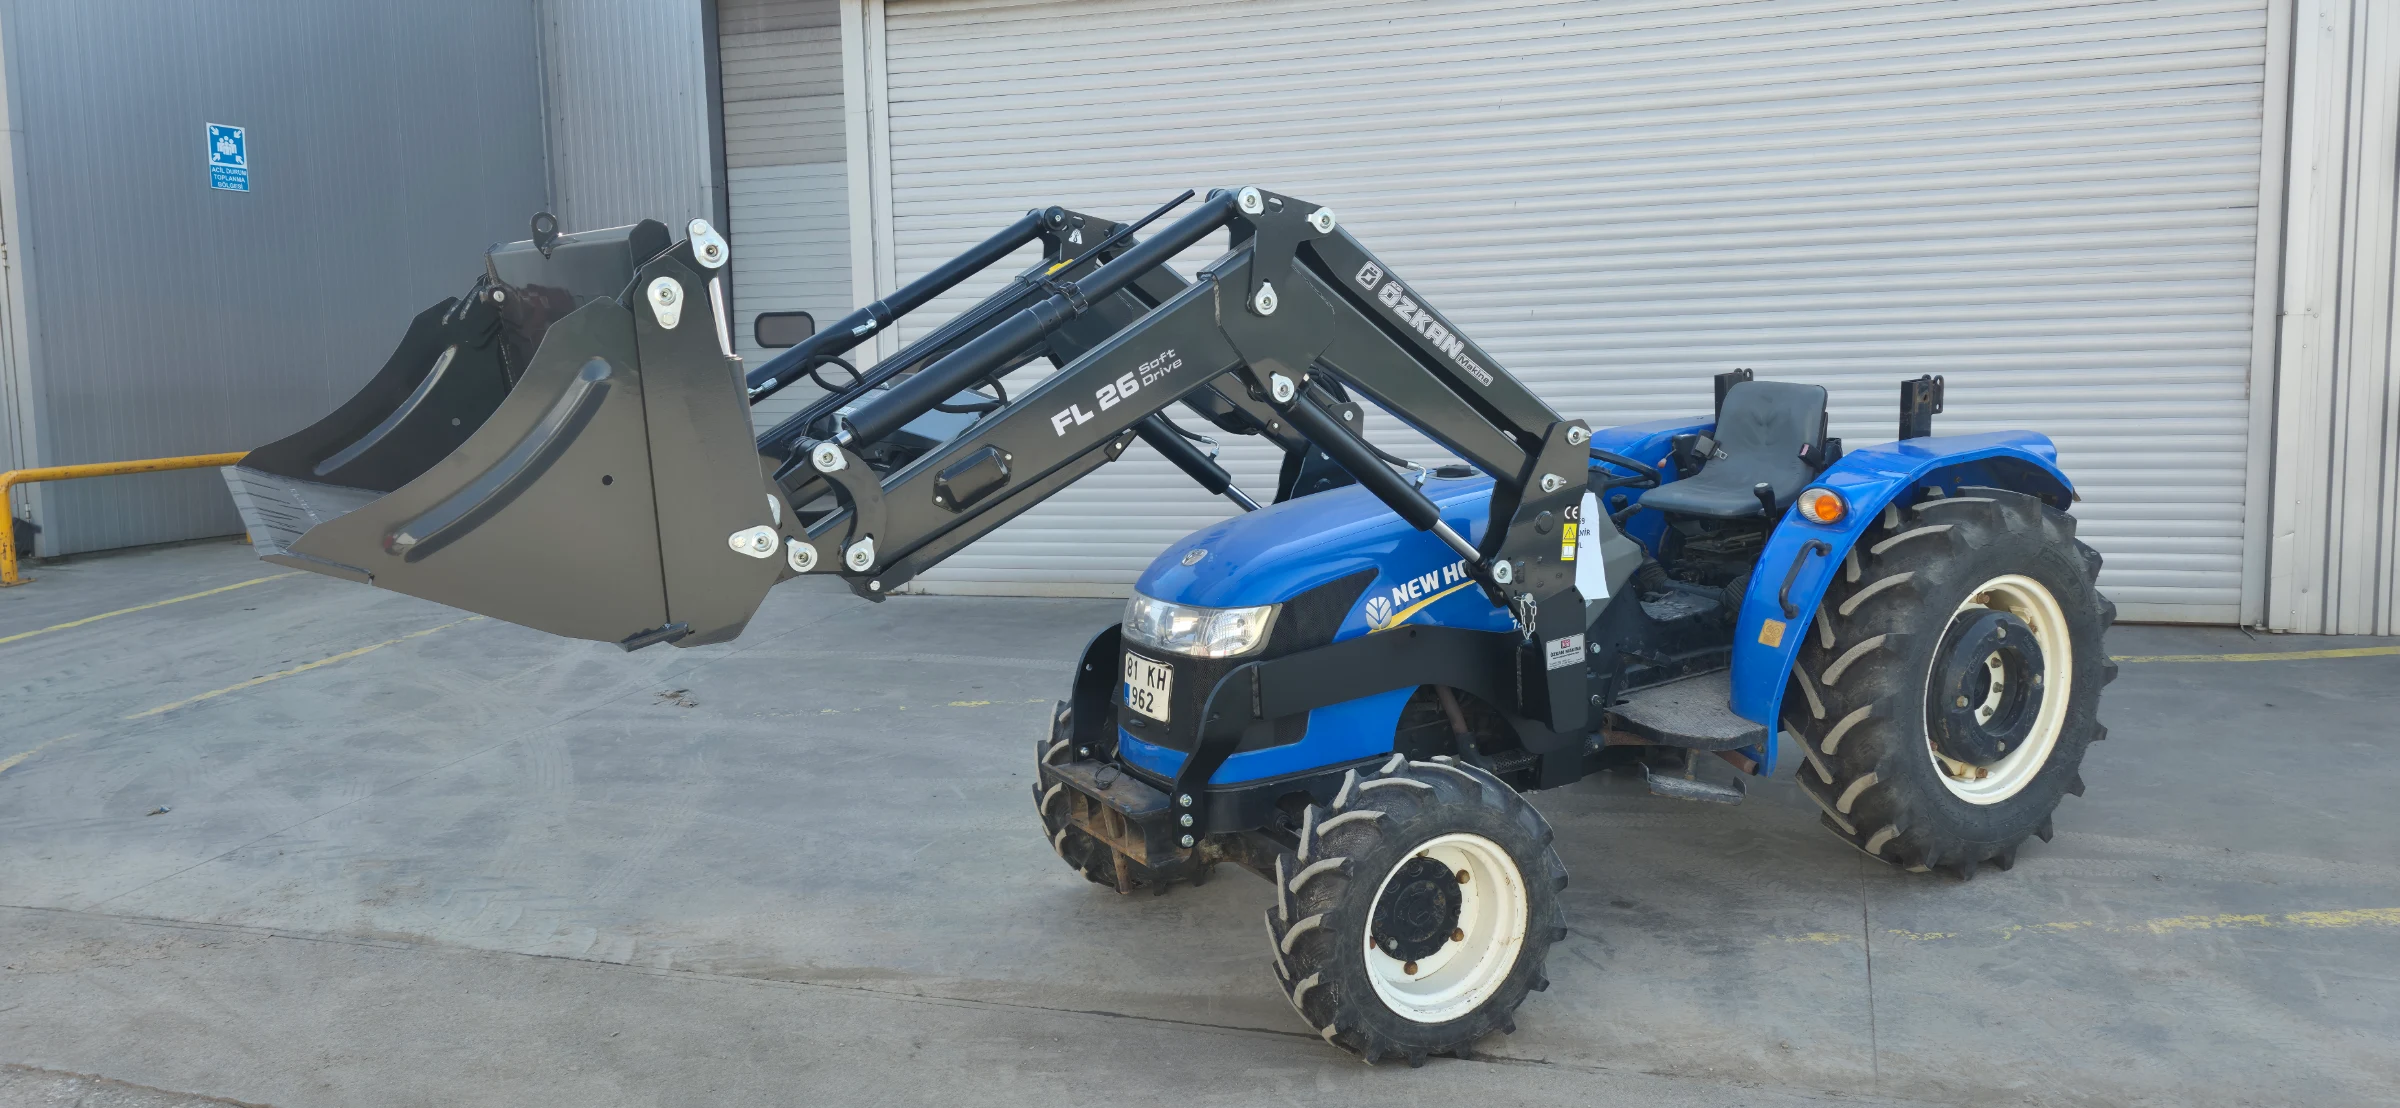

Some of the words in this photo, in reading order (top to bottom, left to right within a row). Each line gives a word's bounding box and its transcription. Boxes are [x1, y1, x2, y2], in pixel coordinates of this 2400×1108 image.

[214, 174, 245, 183] TOPLANMA
[1378, 280, 1465, 360] ÖZKAN
[1458, 354, 1492, 386] Makina
[1138, 349, 1176, 375] Soft
[1142, 358, 1183, 387] Drive
[1050, 403, 1095, 437] FL
[1095, 371, 1140, 412] 26
[1391, 569, 1441, 607] NEW
[1127, 656, 1138, 681] 81
[1147, 665, 1167, 691] KH
[1132, 686, 1154, 713] 962
